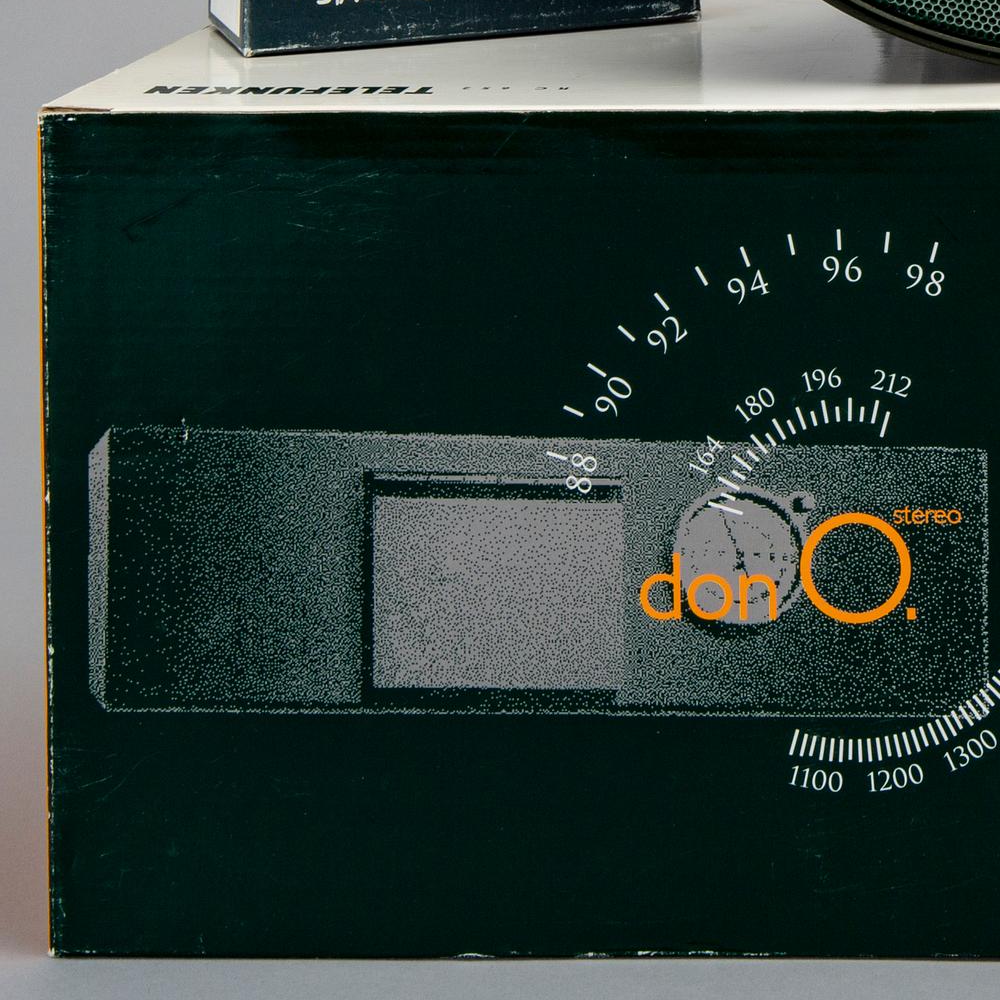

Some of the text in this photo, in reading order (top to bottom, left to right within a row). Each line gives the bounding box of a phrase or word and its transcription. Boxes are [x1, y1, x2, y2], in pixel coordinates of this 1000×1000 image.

[144, 85, 434, 96] TELEFUNKEN
[822, 255, 863, 283] 96
[906, 264, 945, 297] 98
[728, 269, 770, 304] 94
[647, 316, 688, 354] 92
[595, 376, 632, 417] 90
[802, 368, 842, 393] 196
[870, 369, 912, 398] 212
[734, 387, 777, 424] 180
[566, 452, 598, 494] 88
[690, 435, 724, 478] 164
[892, 506, 962, 525] stereo
[640, 553, 777, 621] don
[943, 729, 998, 772] 1300
[790, 765, 844, 793] 1100
[867, 763, 924, 792] 1200
